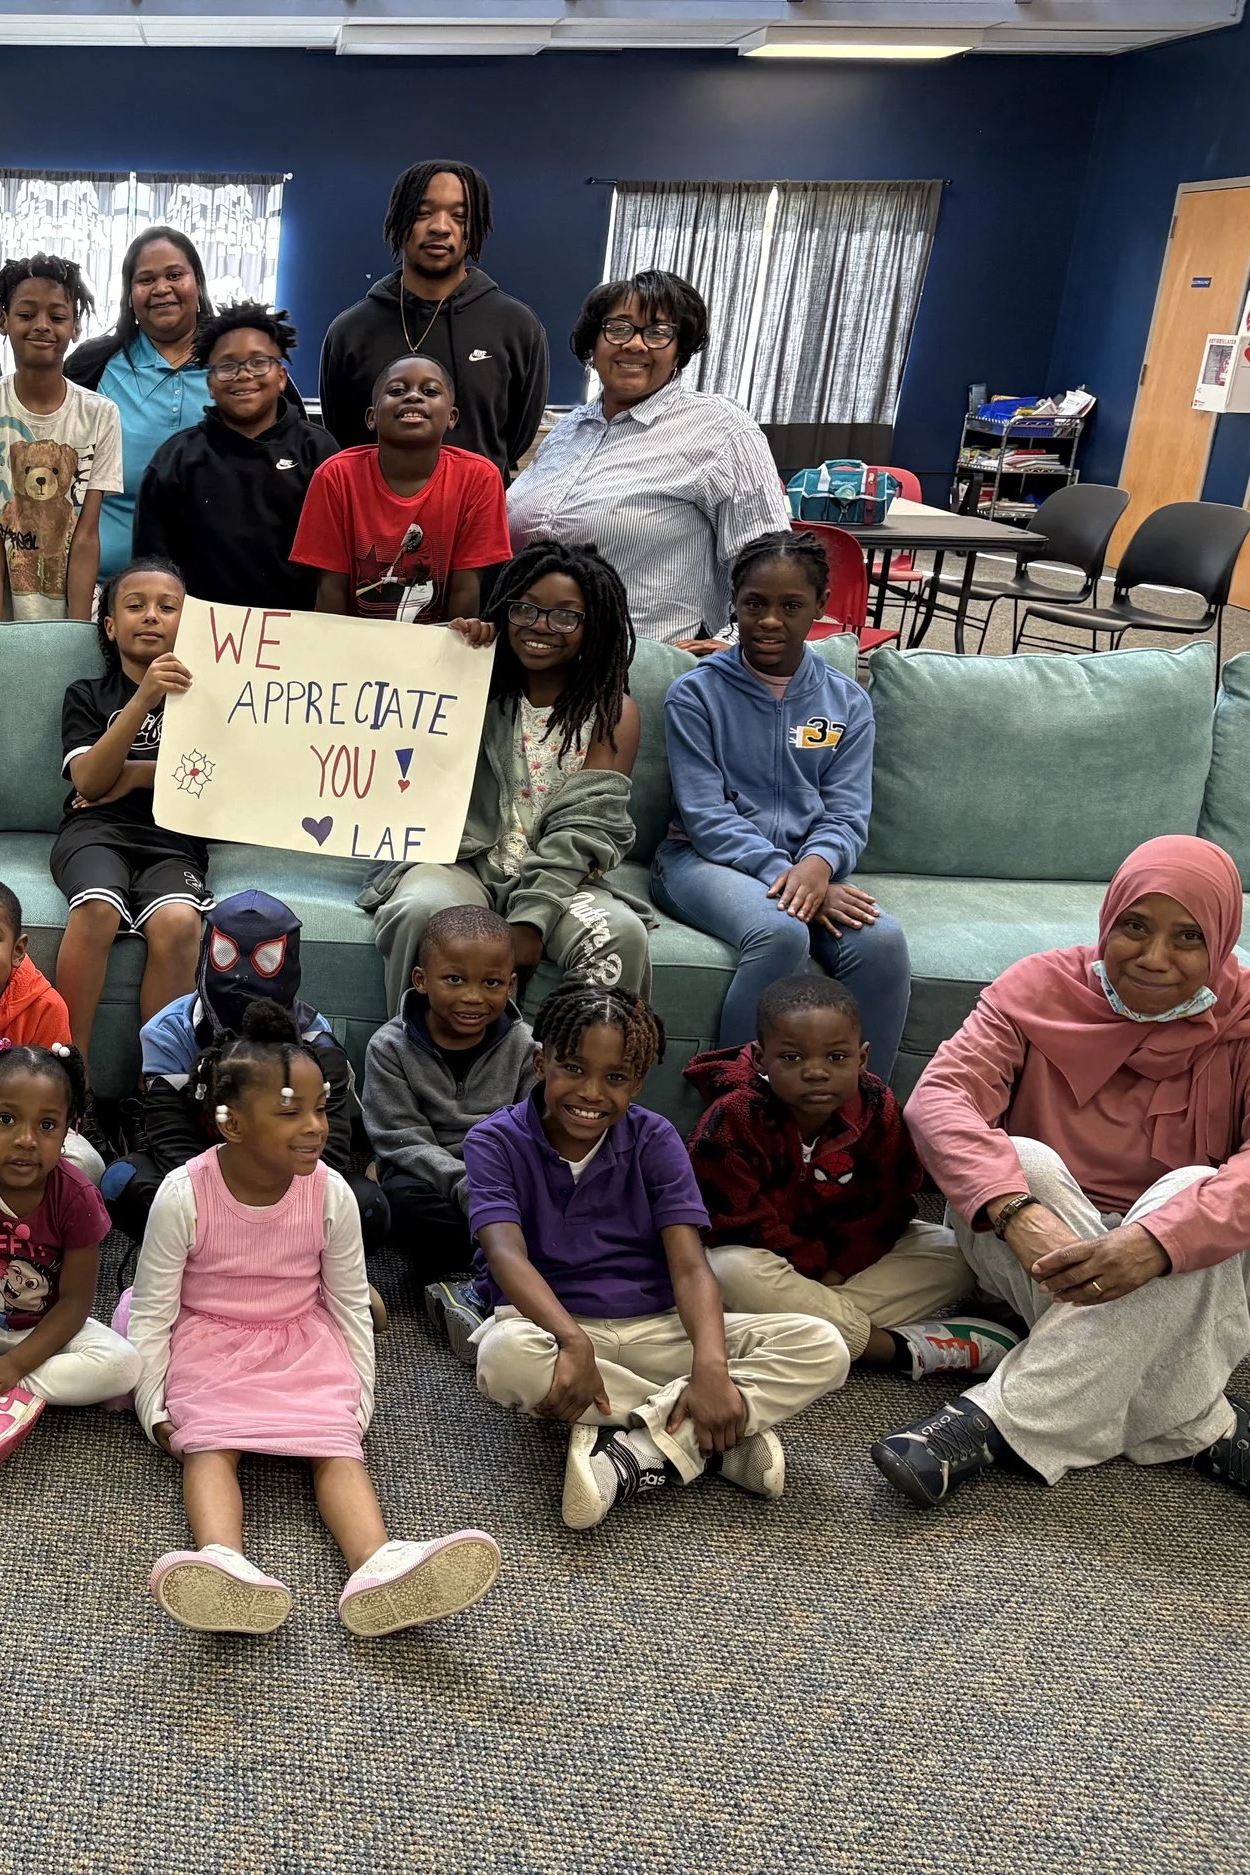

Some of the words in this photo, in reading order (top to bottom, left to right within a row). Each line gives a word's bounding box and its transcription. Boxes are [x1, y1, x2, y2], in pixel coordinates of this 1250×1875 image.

[210, 607, 291, 670] WE
[228, 681, 458, 736] APPRECIATE
[807, 716, 847, 751] 37
[310, 745, 376, 799] YOU
[350, 824, 426, 861] LAF
[639, 1471, 666, 1487] das
